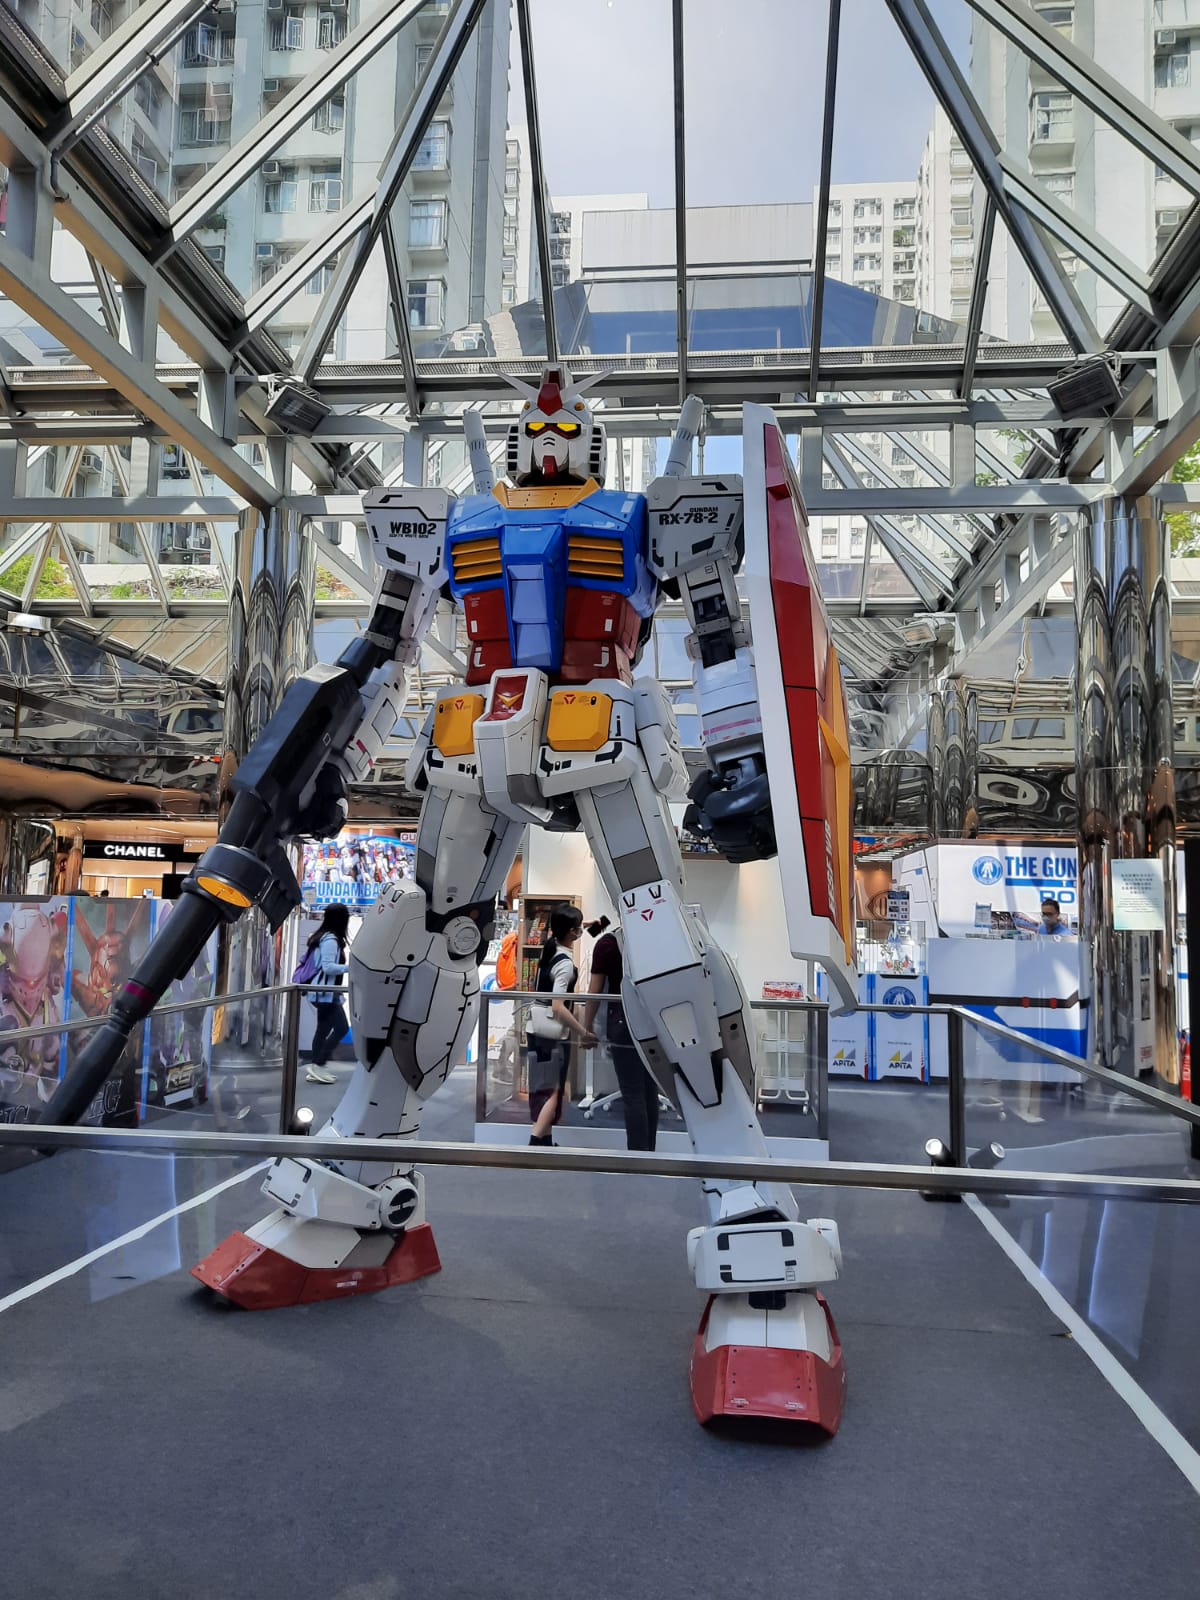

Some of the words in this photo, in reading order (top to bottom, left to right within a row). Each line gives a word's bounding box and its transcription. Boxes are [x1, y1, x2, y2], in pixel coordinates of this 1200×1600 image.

[659, 512, 718, 526] RX-78-2
[390, 521, 437, 535] WB102
[103, 844, 165, 858] CHANEL
[1004, 855, 1037, 877] THE
[311, 881, 361, 898] UNDAM
